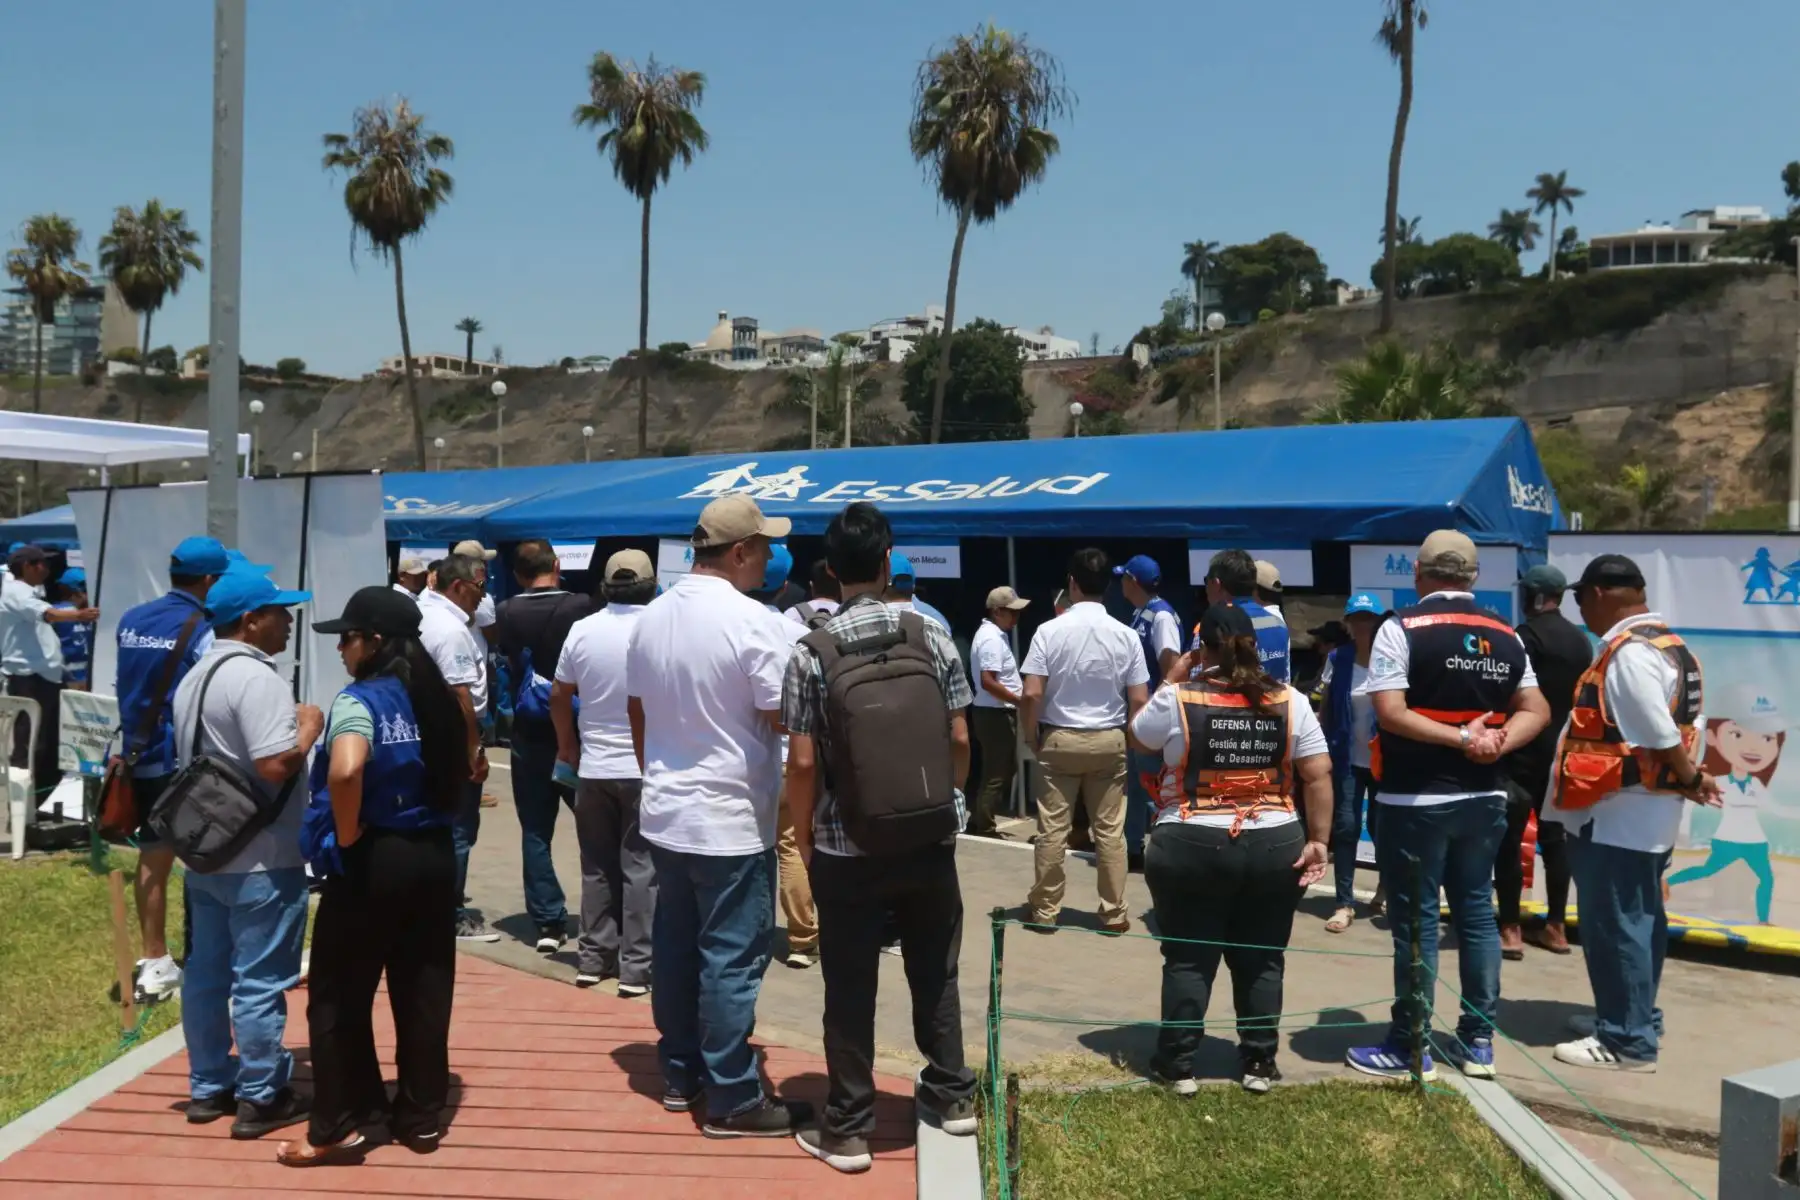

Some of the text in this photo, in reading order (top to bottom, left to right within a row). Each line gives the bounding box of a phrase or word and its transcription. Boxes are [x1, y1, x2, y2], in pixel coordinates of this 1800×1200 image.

[808, 472, 1111, 502] EsSalud
[1446, 654, 1511, 674] chorrillos
[1211, 719, 1277, 731] DEFENSA CIVIL
[1209, 738, 1278, 752] Gestión del Riesgo
[1214, 753, 1272, 764] de Desastres
